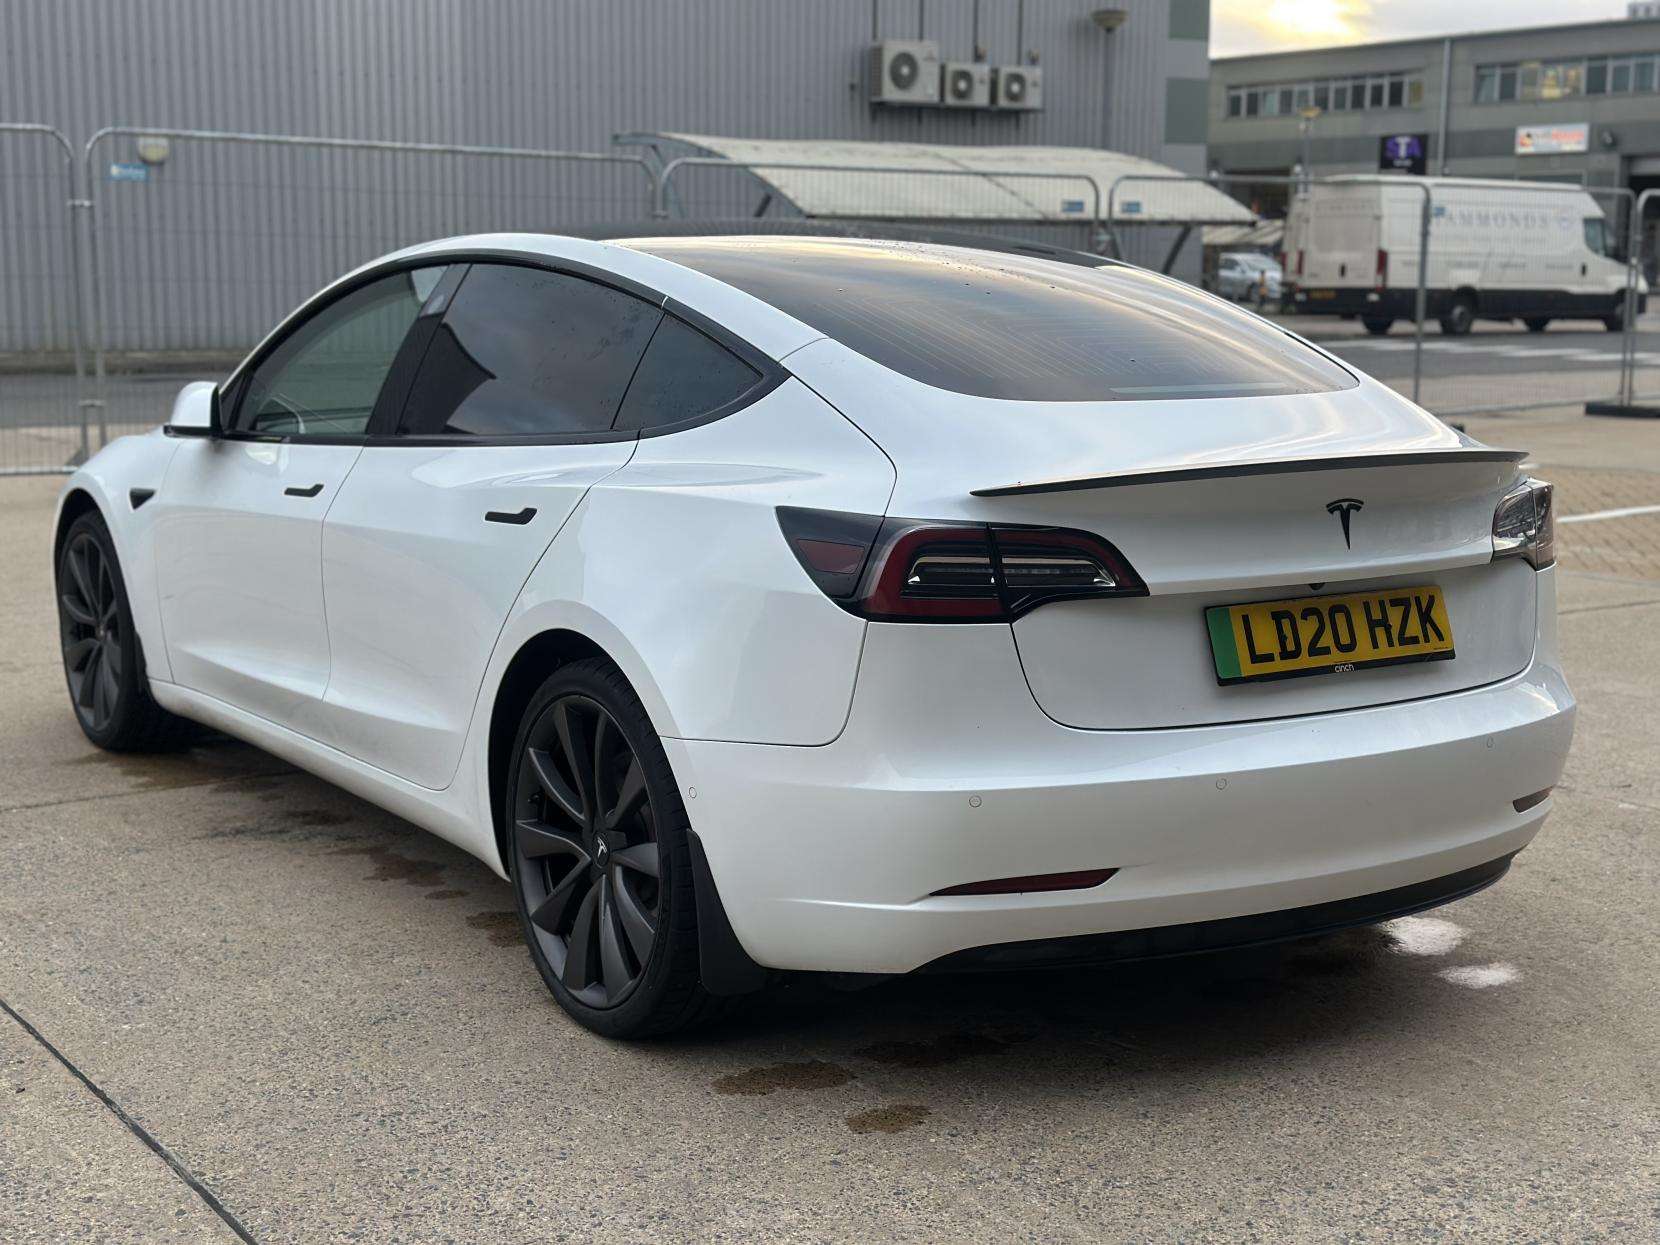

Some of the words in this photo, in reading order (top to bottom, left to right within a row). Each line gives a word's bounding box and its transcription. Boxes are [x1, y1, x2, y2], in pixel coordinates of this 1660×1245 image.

[1241, 604, 1358, 664] LD20
[1363, 595, 1445, 650] HZK
[1334, 664, 1355, 673] cinch
